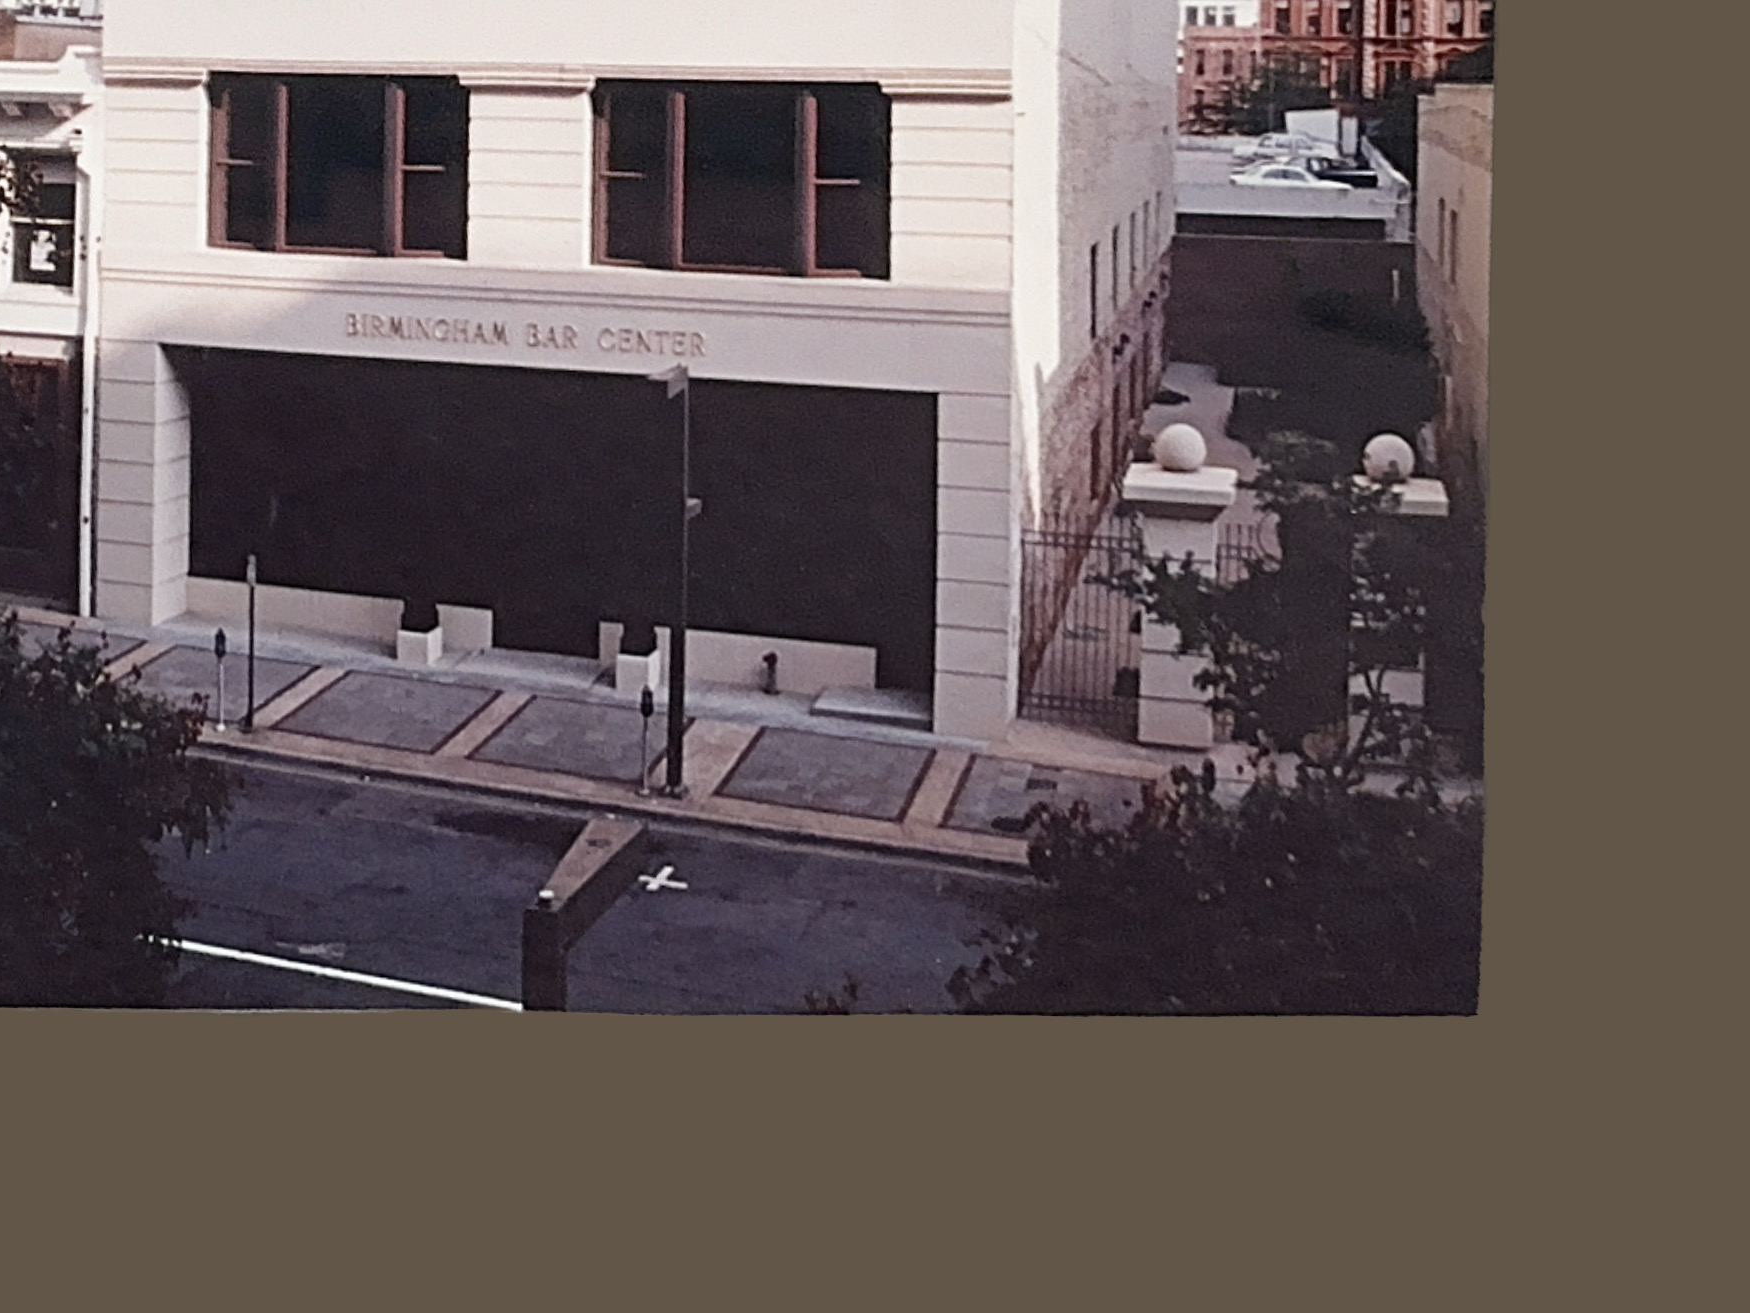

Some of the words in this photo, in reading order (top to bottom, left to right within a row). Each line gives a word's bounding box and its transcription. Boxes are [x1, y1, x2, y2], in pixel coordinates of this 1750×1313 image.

[346, 312, 510, 346] BIRMINGHAM
[525, 322, 578, 349] BAR
[597, 326, 706, 357] CENTER
